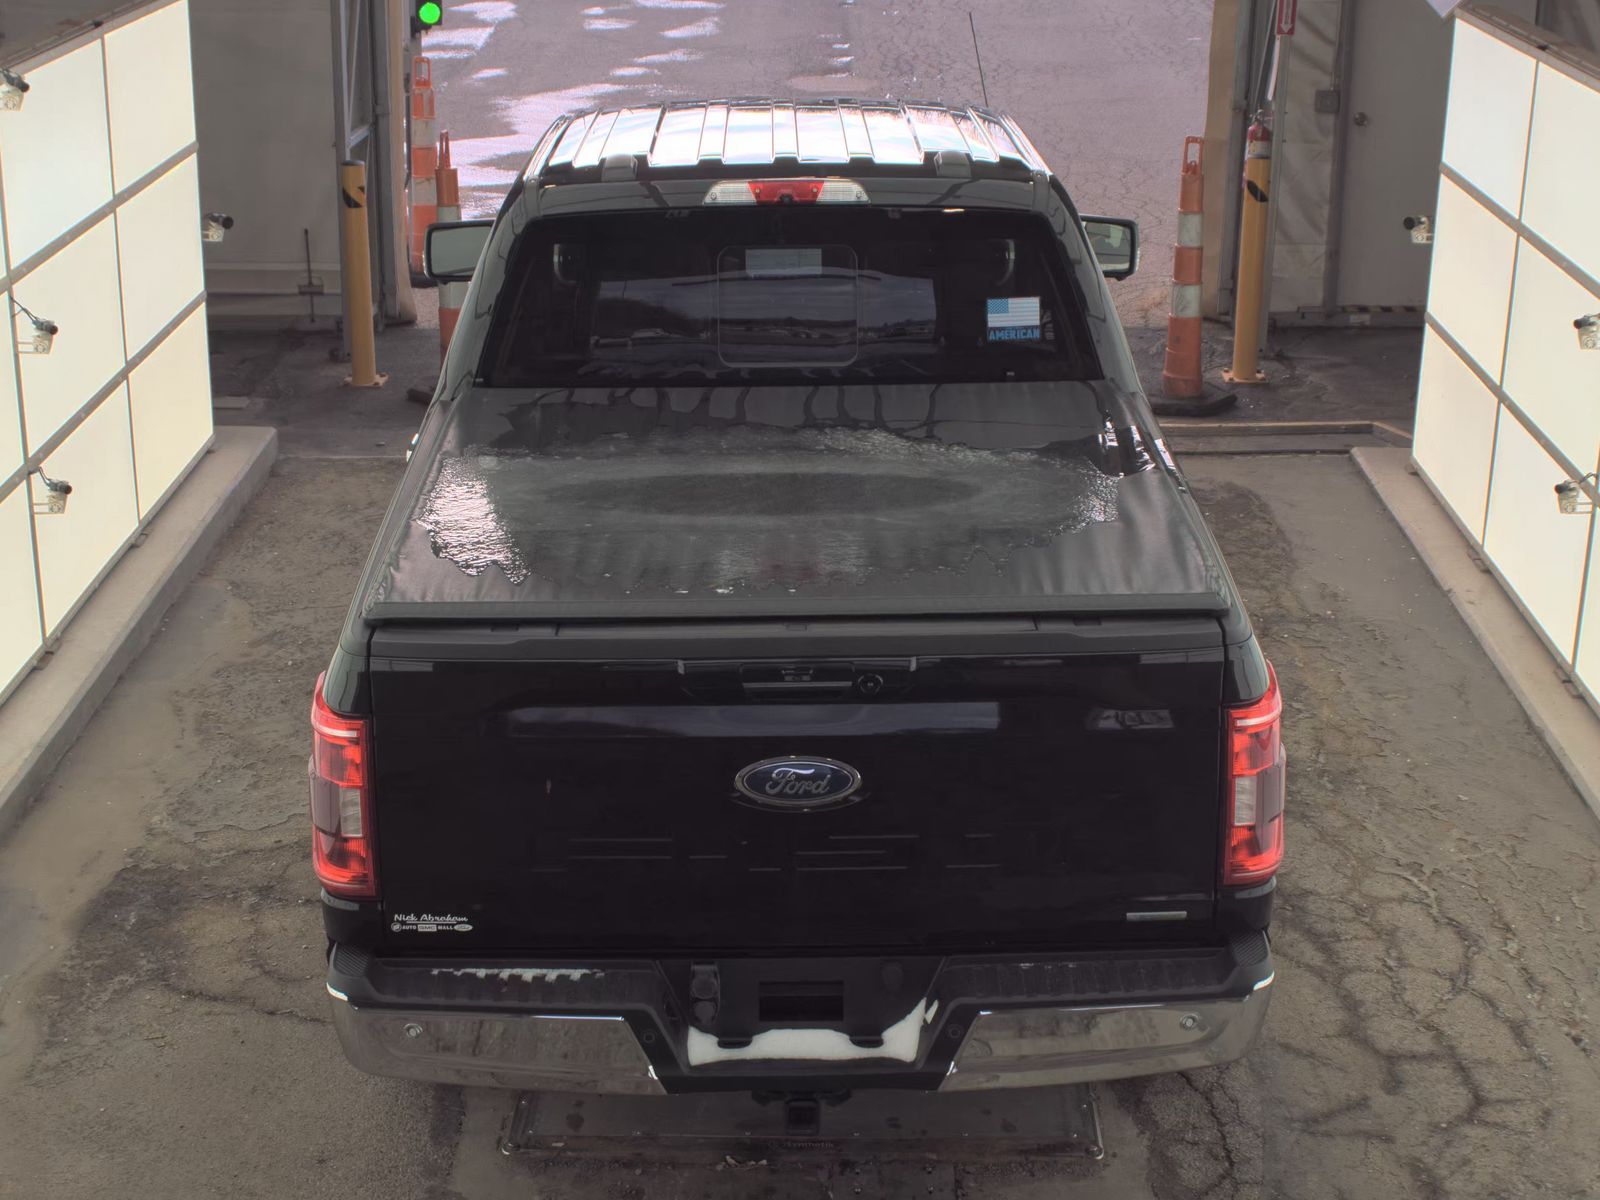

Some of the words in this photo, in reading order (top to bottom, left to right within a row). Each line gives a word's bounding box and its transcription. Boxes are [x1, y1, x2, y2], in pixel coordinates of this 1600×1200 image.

[989, 328, 1040, 341] AMERICAN
[765, 767, 831, 795] Ford
[394, 913, 417, 922] Nick
[420, 913, 468, 922] Abraham
